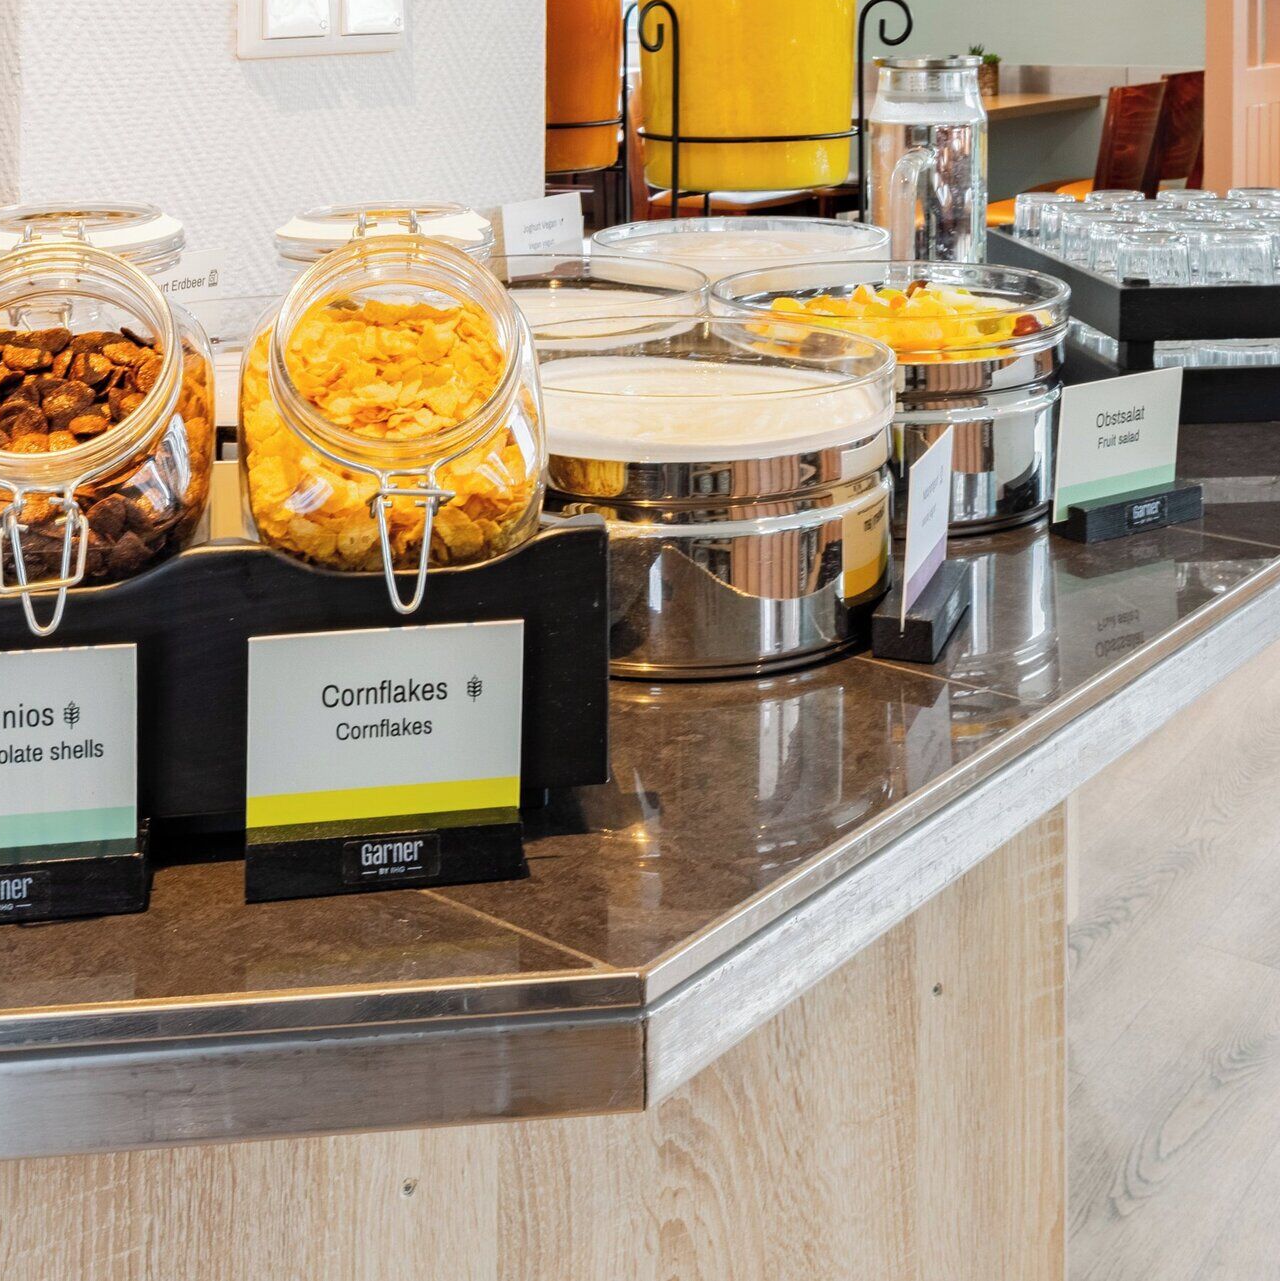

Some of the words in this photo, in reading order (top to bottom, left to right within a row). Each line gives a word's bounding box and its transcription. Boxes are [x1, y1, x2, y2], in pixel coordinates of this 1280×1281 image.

[171, 276, 206, 291] Erdbeer
[1096, 405, 1145, 428] Obstsalat
[1098, 433, 1117, 449] Fruit
[1118, 429, 1140, 445] salad
[321, 677, 448, 709] Cornflakes
[336, 717, 433, 741] Cornflakes
[50, 739, 104, 760] shells
[361, 840, 424, 866] Garner
